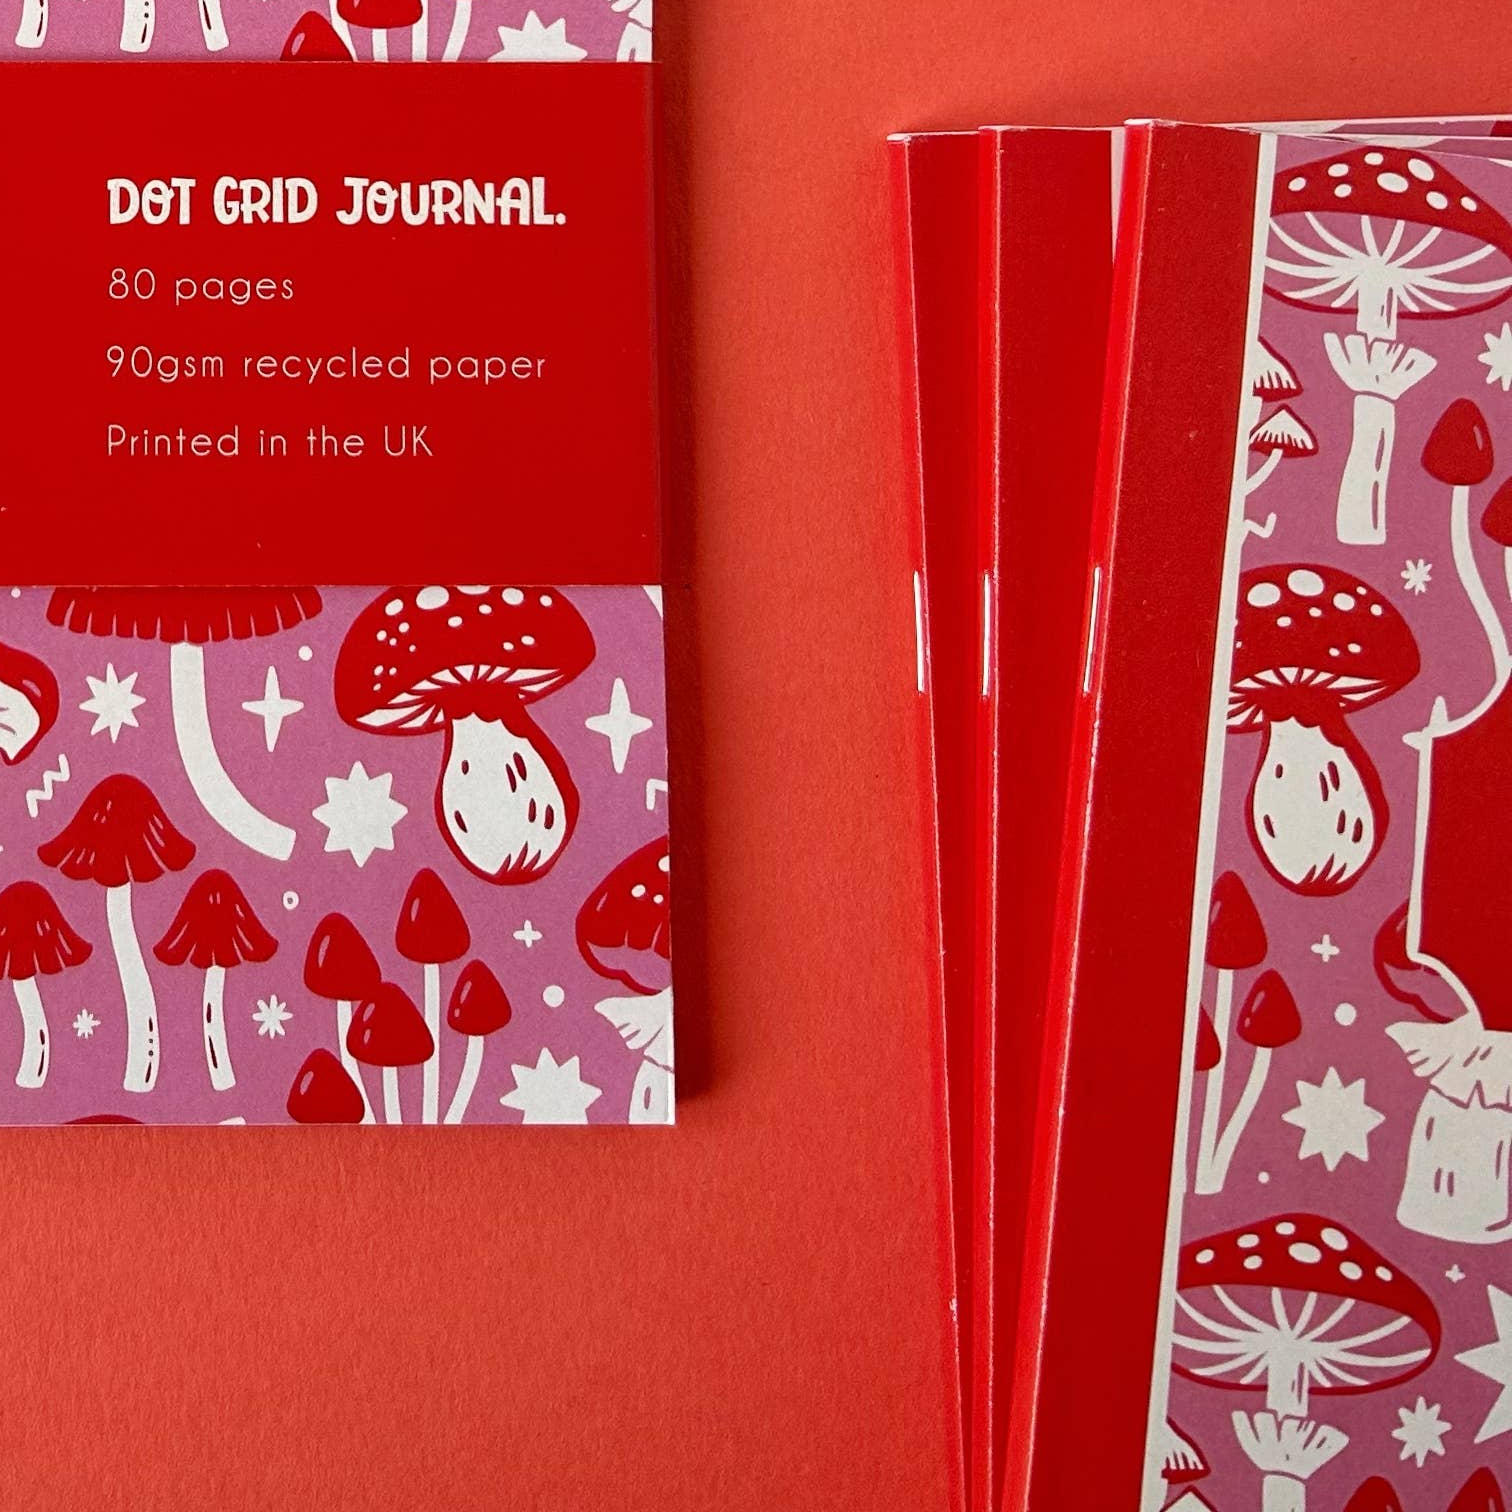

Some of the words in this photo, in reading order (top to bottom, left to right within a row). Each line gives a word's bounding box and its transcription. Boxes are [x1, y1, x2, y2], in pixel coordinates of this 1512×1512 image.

[106, 177, 197, 225] DOT
[213, 175, 318, 225] GRID
[335, 176, 568, 226] JOURNAL.
[108, 268, 156, 300] 80
[175, 277, 294, 306] pages
[106, 345, 224, 383] 90gsm
[244, 346, 410, 385] recycled
[430, 355, 546, 385] paper
[107, 424, 239, 457] Printed
[259, 429, 287, 456] in
[306, 424, 365, 457] the
[384, 425, 434, 457] UK
